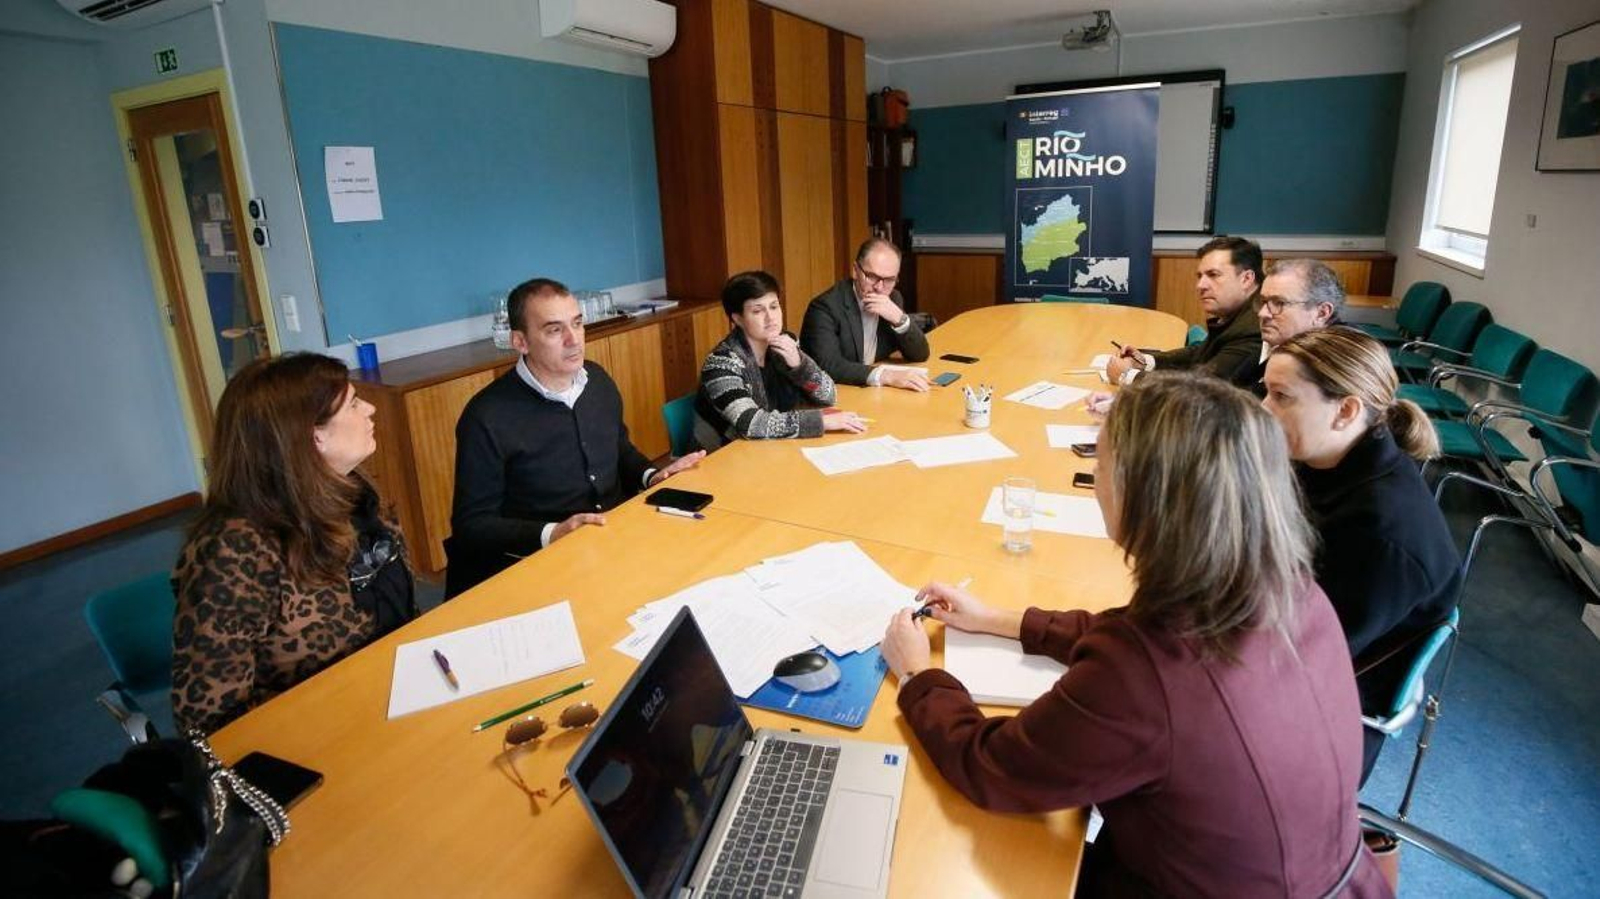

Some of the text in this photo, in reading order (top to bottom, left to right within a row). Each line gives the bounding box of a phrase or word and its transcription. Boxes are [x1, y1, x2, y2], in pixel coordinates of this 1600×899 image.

[1019, 142, 1030, 176] AECT
[1034, 155, 1127, 178] MINHO
[641, 687, 665, 721] 10:42
